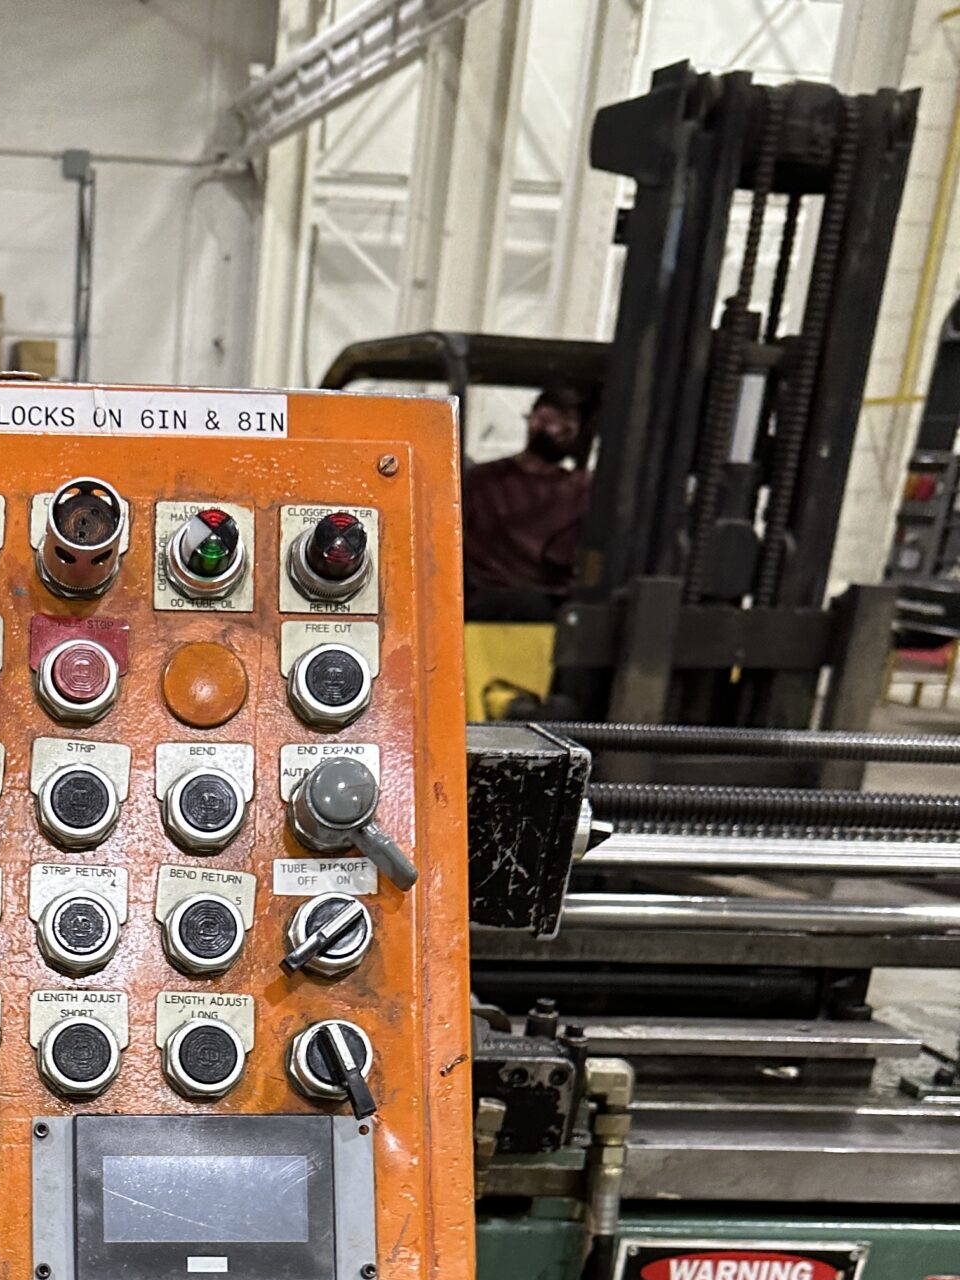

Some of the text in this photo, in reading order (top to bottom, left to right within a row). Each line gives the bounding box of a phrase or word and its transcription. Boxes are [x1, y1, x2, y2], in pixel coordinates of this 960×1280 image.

[93, 406, 122, 428] ON
[140, 409, 187, 429] 6IN
[205, 410, 220, 430] &
[238, 411, 285, 432] 8IN
[288, 508, 333, 517] CLOGGED
[221, 600, 236, 609] OIL
[309, 604, 350, 612] RETURN
[87, 619, 114, 629] STOP
[305, 624, 352, 633] FREE CUT
[67, 743, 96, 753] STRIP
[189, 746, 216, 756] BEND
[297, 746, 365, 755] END EXPAND
[42, 866, 117, 877] STRIP RETURN
[281, 862, 367, 873] TUBE PICKOFF
[169, 868, 242, 884] BEND RETURN
[298, 875, 351, 885] OFF ON
[235, 897, 241, 906] 5
[37, 993, 122, 1003] LENGTH ADJUST
[164, 995, 248, 1006] LENGTH ADJUST
[60, 1009, 94, 1017] SHORT
[191, 1011, 218, 1019] LONG
